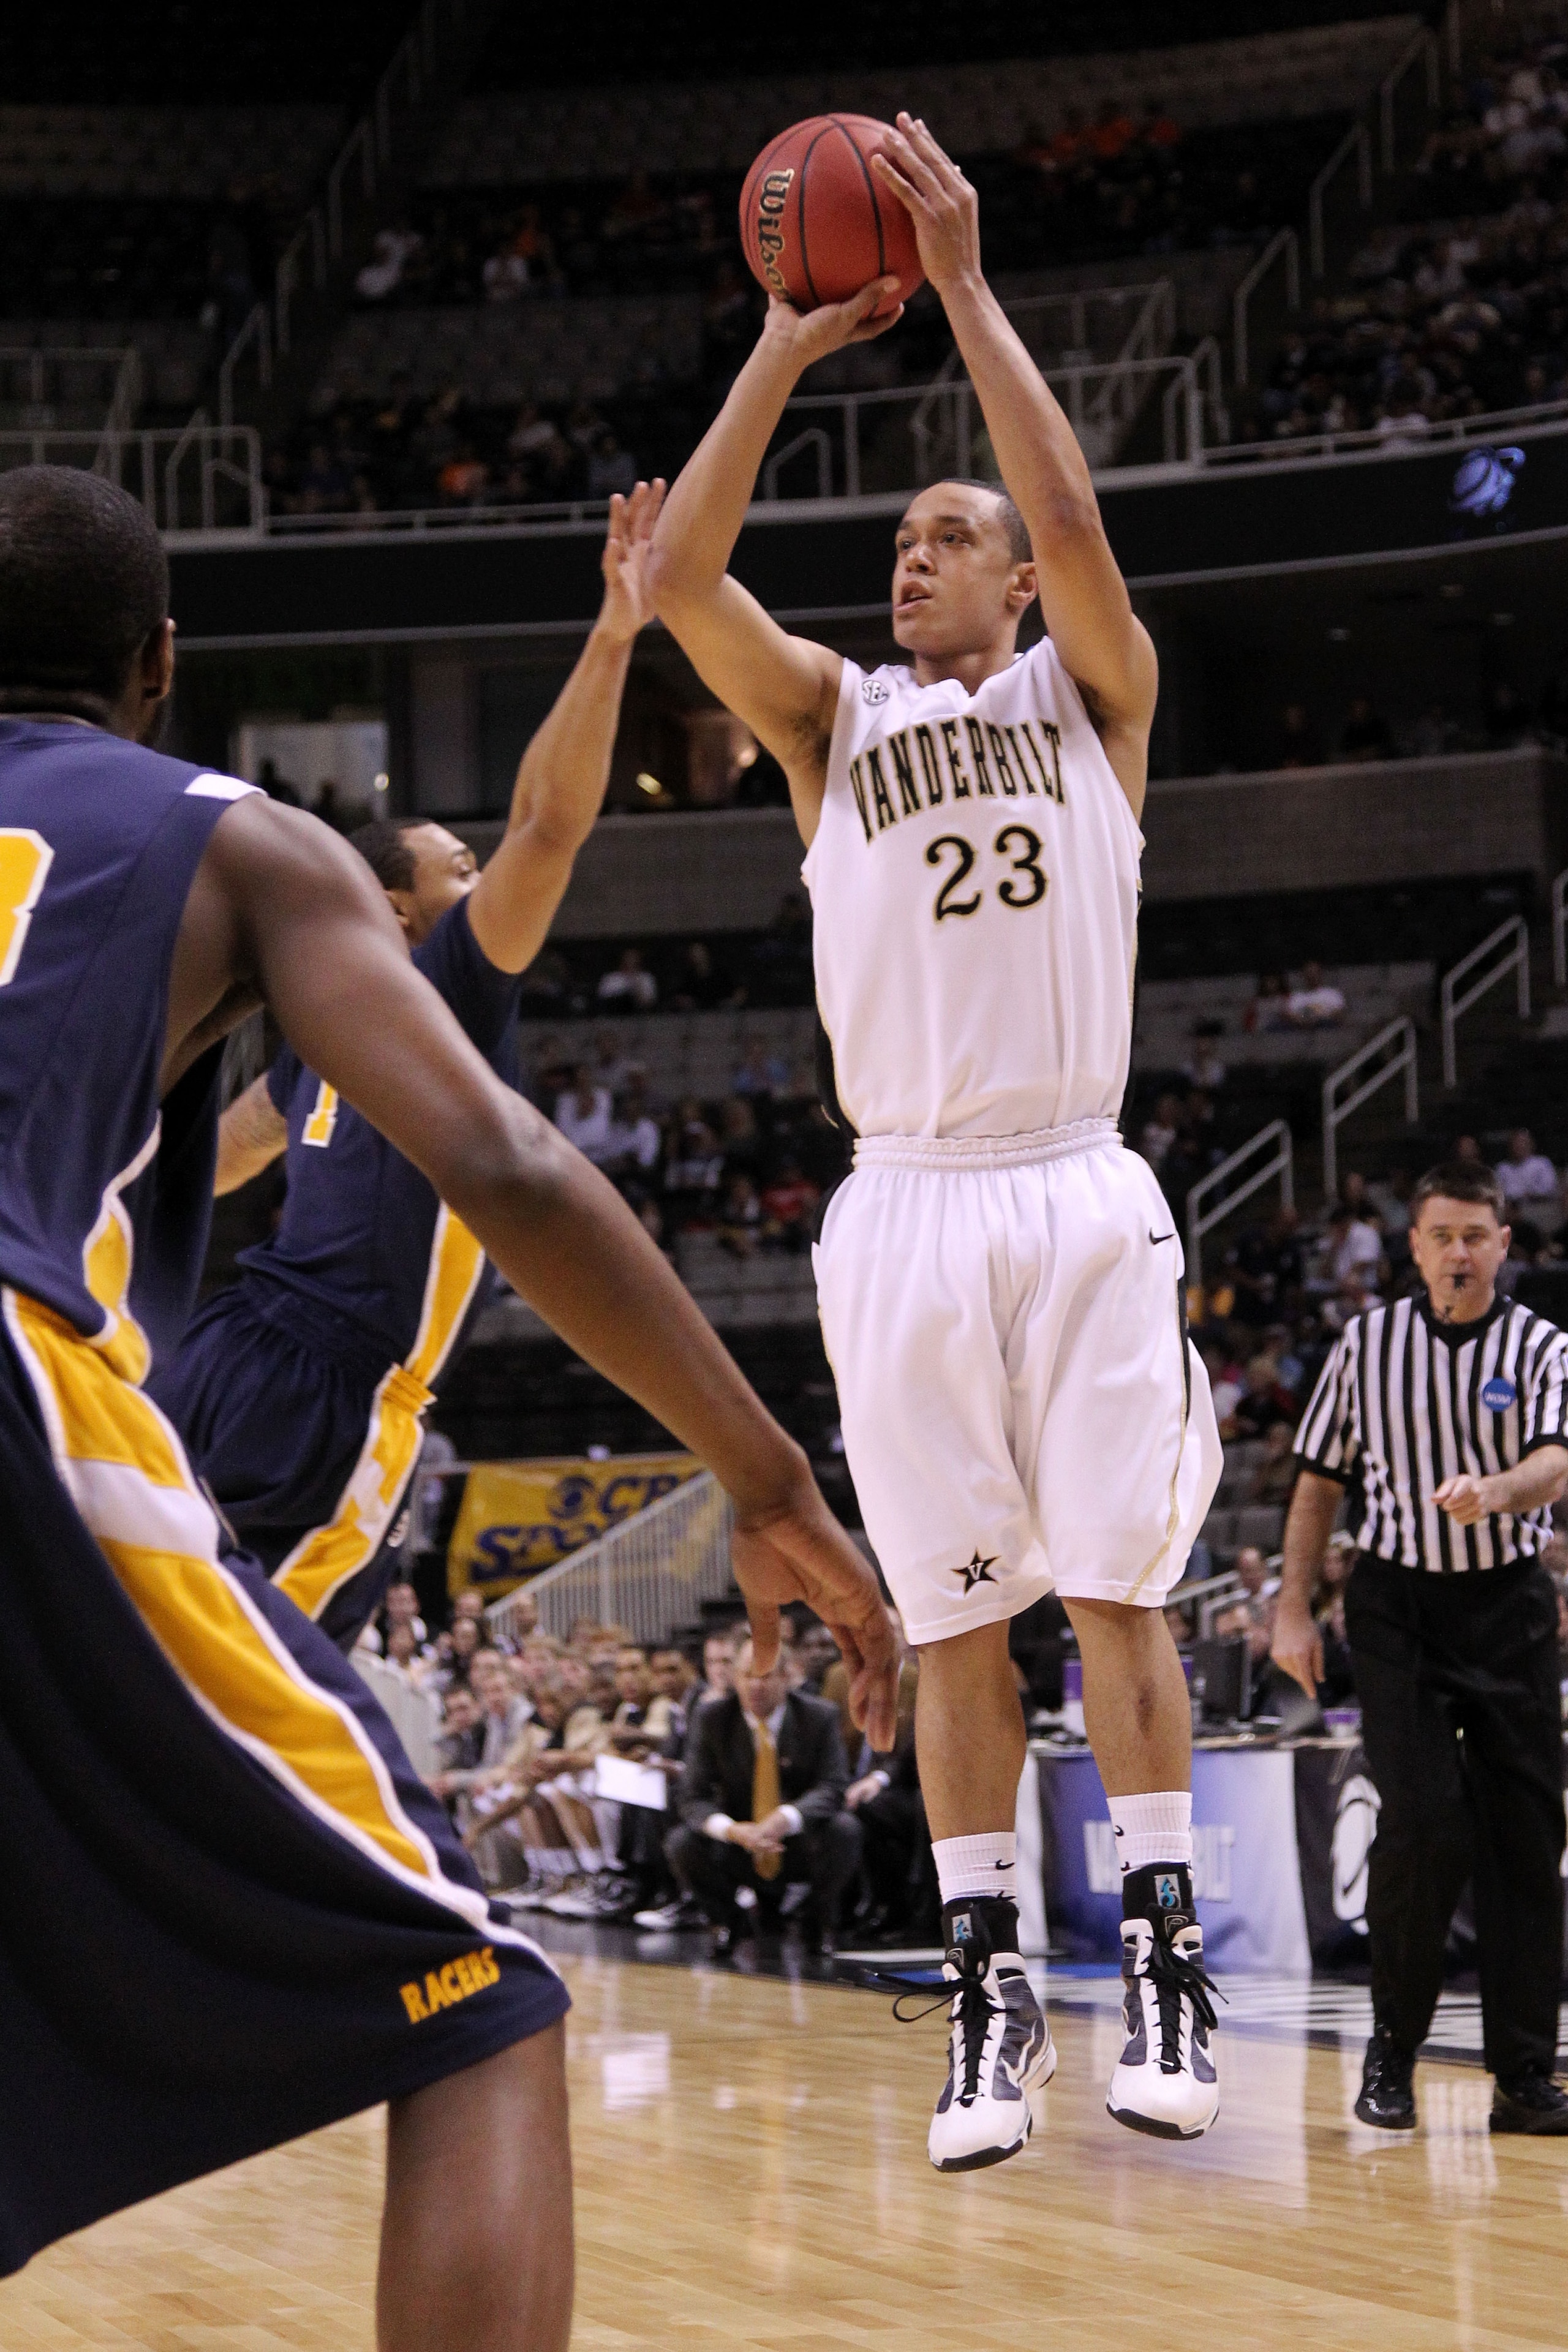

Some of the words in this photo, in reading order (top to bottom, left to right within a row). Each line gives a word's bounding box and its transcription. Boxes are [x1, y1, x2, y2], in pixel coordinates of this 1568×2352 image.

[850, 715, 1066, 847] VANDERBILT
[925, 823, 1049, 923] 23
[399, 1945, 500, 2024] RACERS
